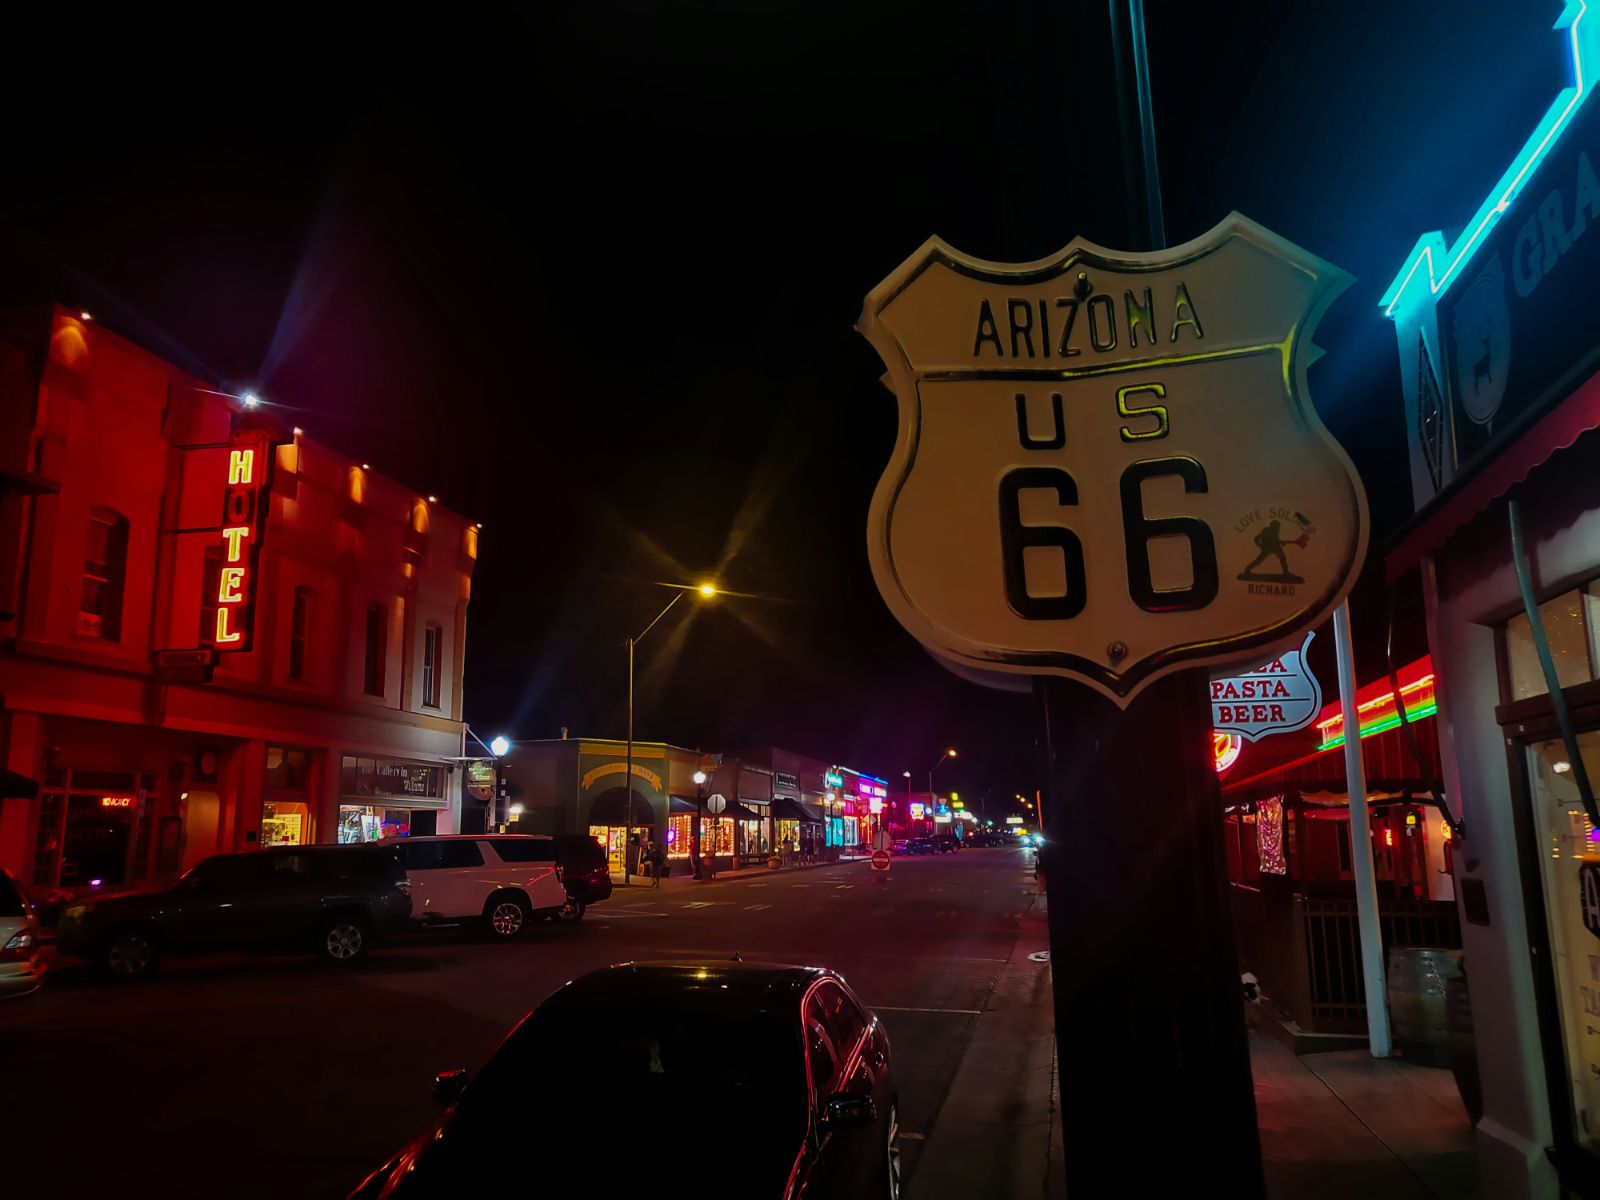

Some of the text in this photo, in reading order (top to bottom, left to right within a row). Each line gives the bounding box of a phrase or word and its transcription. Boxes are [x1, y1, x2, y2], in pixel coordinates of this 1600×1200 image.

[973, 281, 1204, 359] ARIZONA
[1015, 382, 1170, 450] U S
[999, 456, 1219, 621] 66
[1233, 509, 1264, 533] LOVE
[216, 450, 254, 642] HOTEL
[1248, 583, 1296, 596] RICHARD
[1210, 679, 1291, 699] PASTA
[1218, 704, 1286, 723] BEER
